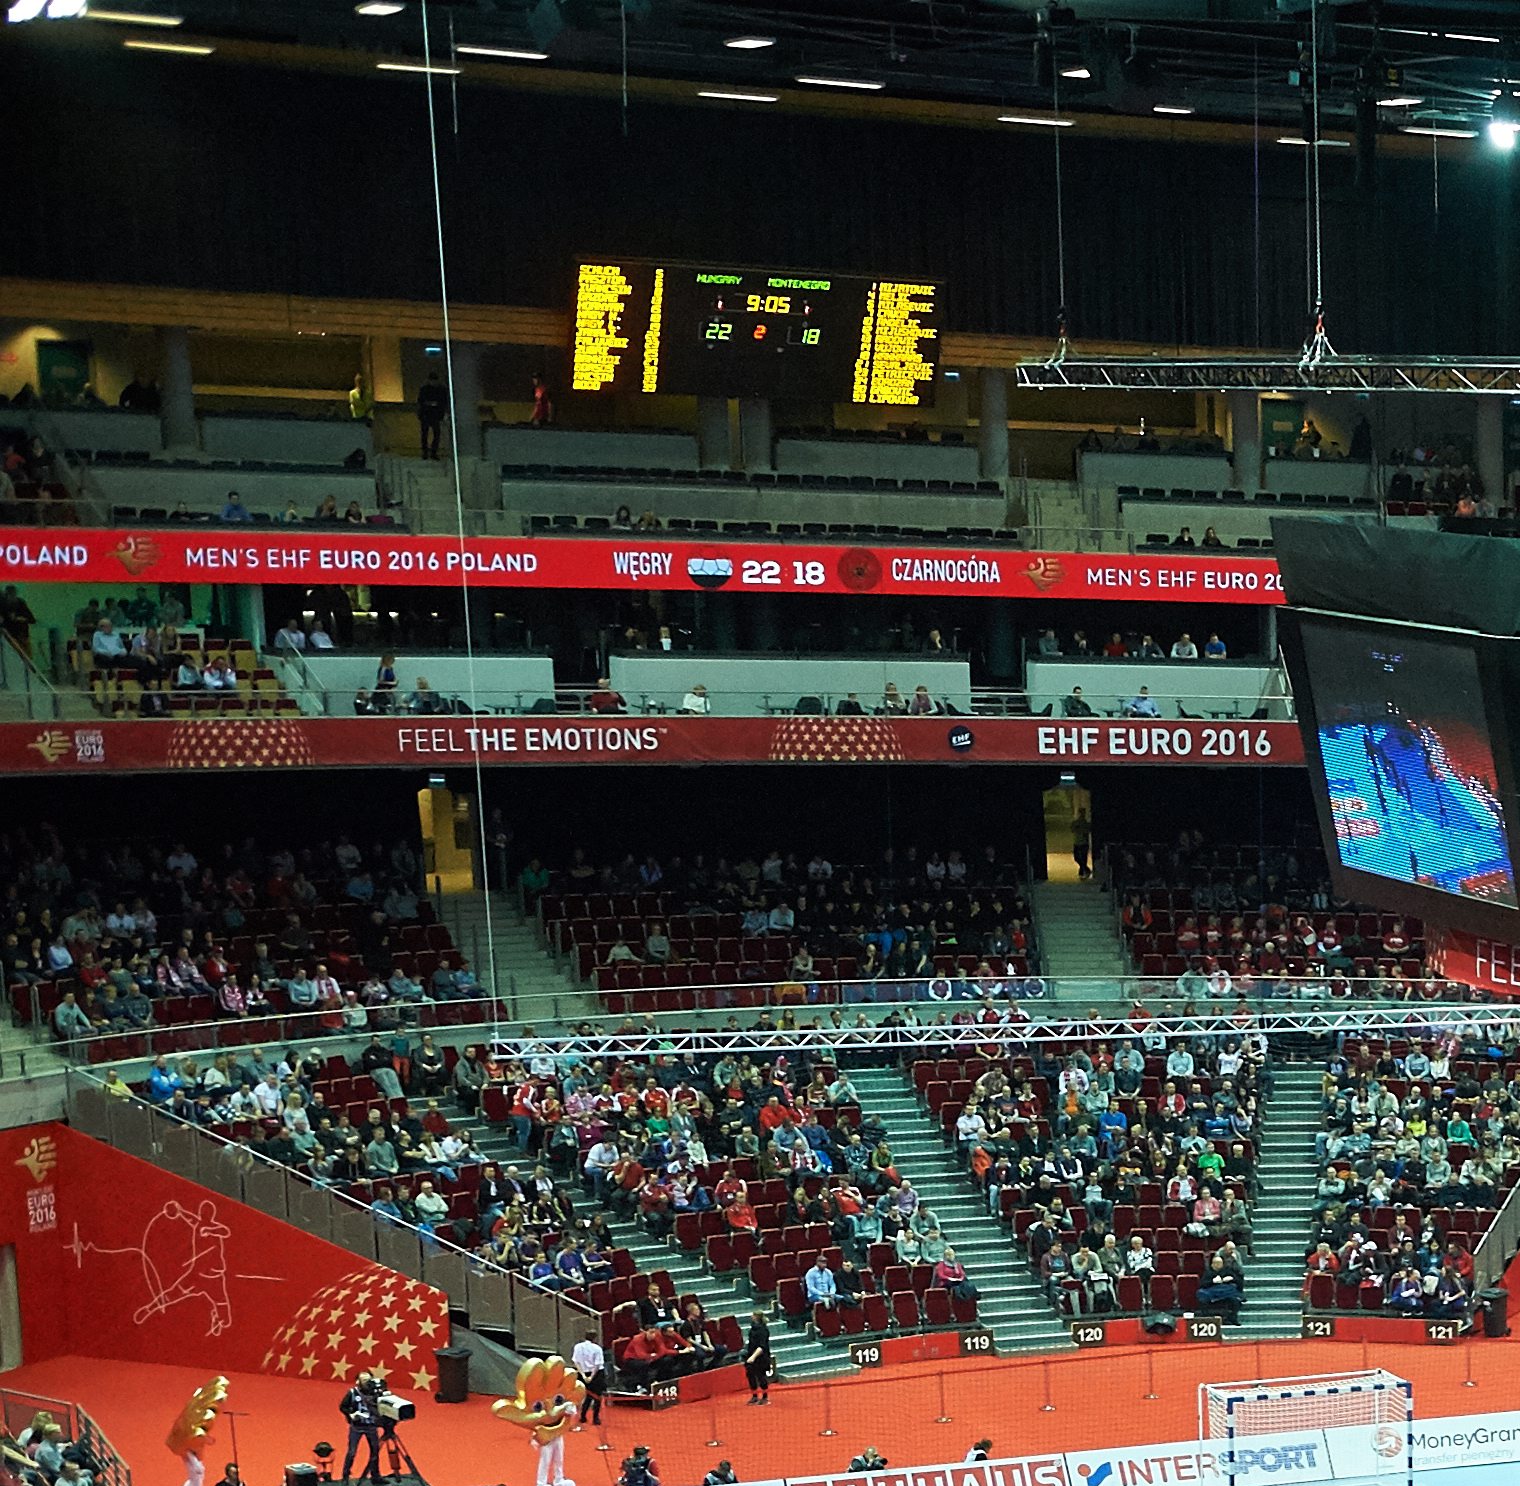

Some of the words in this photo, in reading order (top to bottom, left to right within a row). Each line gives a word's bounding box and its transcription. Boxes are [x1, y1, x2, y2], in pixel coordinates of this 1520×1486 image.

[746, 295, 790, 314] 9:05
[706, 324, 732, 340] 22
[802, 329, 820, 345] 18
[186, 547, 259, 568] MEN'S
[267, 548, 310, 569] EHF
[320, 549, 381, 571] EURO
[388, 550, 440, 572] 2016
[447, 551, 538, 573] POLAND
[613, 552, 672, 581] WĘGRY
[742, 560, 781, 584] 22
[793, 562, 825, 585] 18
[892, 554, 1000, 583] CZARNOGÓRA
[1087, 567, 1150, 588] MEN'S
[1158, 569, 1196, 589] EHF
[1203, 570, 1258, 590] EURO
[399, 728, 464, 752] FEEL
[470, 728, 516, 752] THE
[1038, 726, 1098, 754] EHF
[1109, 728, 1191, 755] EURO
[1202, 729, 1271, 757] 2016
[27, 1193, 55, 1210] EURO
[29, 1205, 56, 1224] 2016
[1078, 1327, 1102, 1342] 120
[1192, 1321, 1216, 1337] 120
[1307, 1321, 1331, 1337] 121
[1429, 1324, 1453, 1340] 121
[965, 1335, 989, 1352] 119
[856, 1347, 878, 1364] 119
[1118, 1442, 1318, 1486] INTERSPORT
